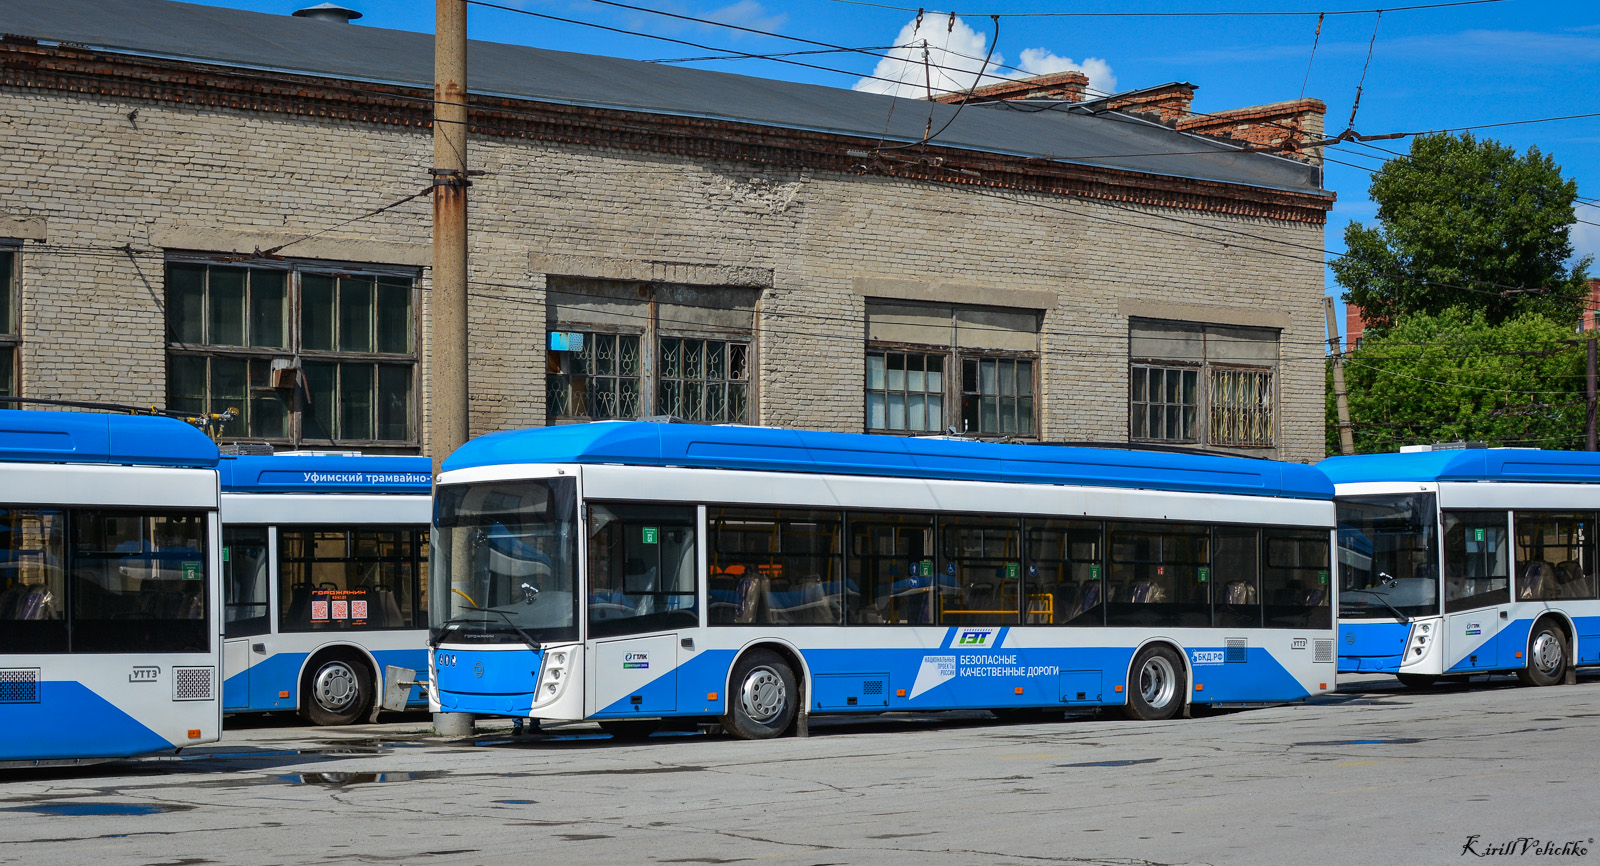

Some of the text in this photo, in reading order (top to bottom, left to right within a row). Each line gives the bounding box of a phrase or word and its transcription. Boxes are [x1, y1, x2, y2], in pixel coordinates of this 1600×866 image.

[303, 472, 363, 484] Уфимский
[960, 655, 1017, 665] БЕЗОПАСНЫЕ
[1198, 653, 1223, 662] БКД.РФ
[133, 670, 157, 679] УТТЗ
[960, 666, 1059, 678] КАЧЕСТВЕННЫЕ ДОРОГИ
